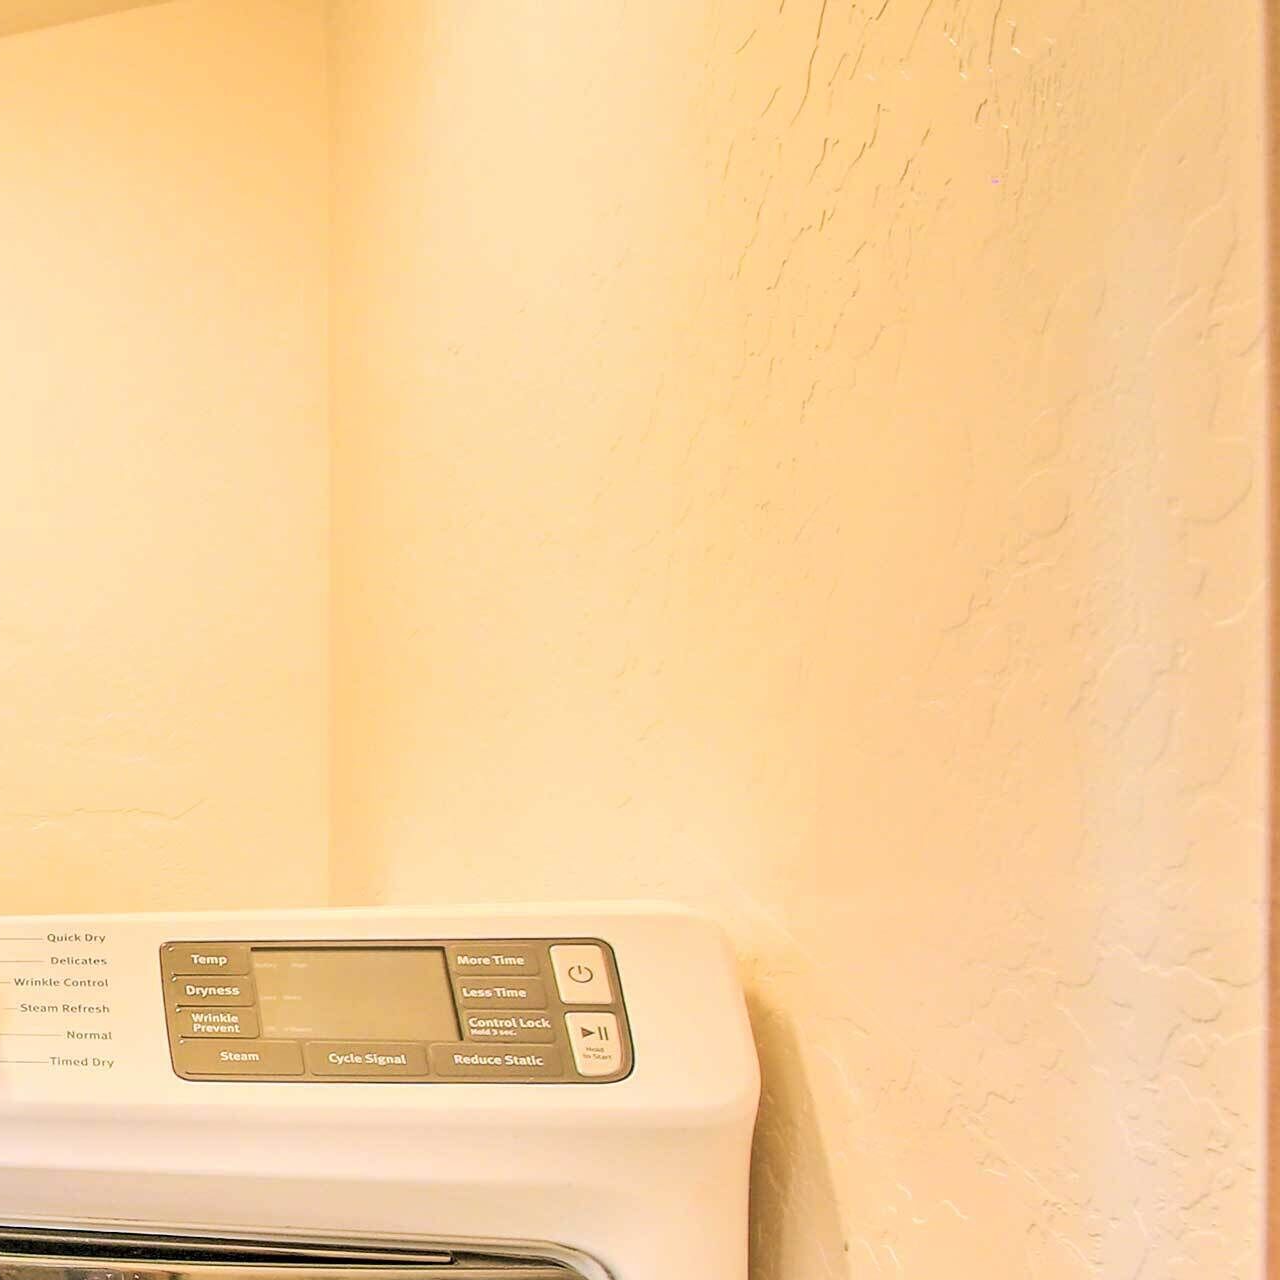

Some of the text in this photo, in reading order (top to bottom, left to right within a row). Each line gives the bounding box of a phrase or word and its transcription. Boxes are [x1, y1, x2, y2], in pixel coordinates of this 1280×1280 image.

[47, 933, 106, 944] Quick Dry
[50, 956, 108, 966] Delicates
[191, 954, 228, 967] Temp
[457, 955, 525, 966] More Time
[14, 978, 109, 988] Wrinkle Control
[185, 984, 240, 998] Dryness
[462, 987, 527, 998] Less Time
[20, 1003, 110, 1013] Steam Refresh
[191, 1013, 239, 1023] Wrinkle
[468, 1017, 552, 1028] Control Lock
[192, 1023, 241, 1034] Prevent
[66, 1030, 112, 1040] Normal
[220, 1051, 260, 1062] Steam
[328, 1053, 407, 1066] Cycle Signal
[453, 1054, 545, 1066] Reduce Static
[49, 1057, 115, 1068] Timed Dry
